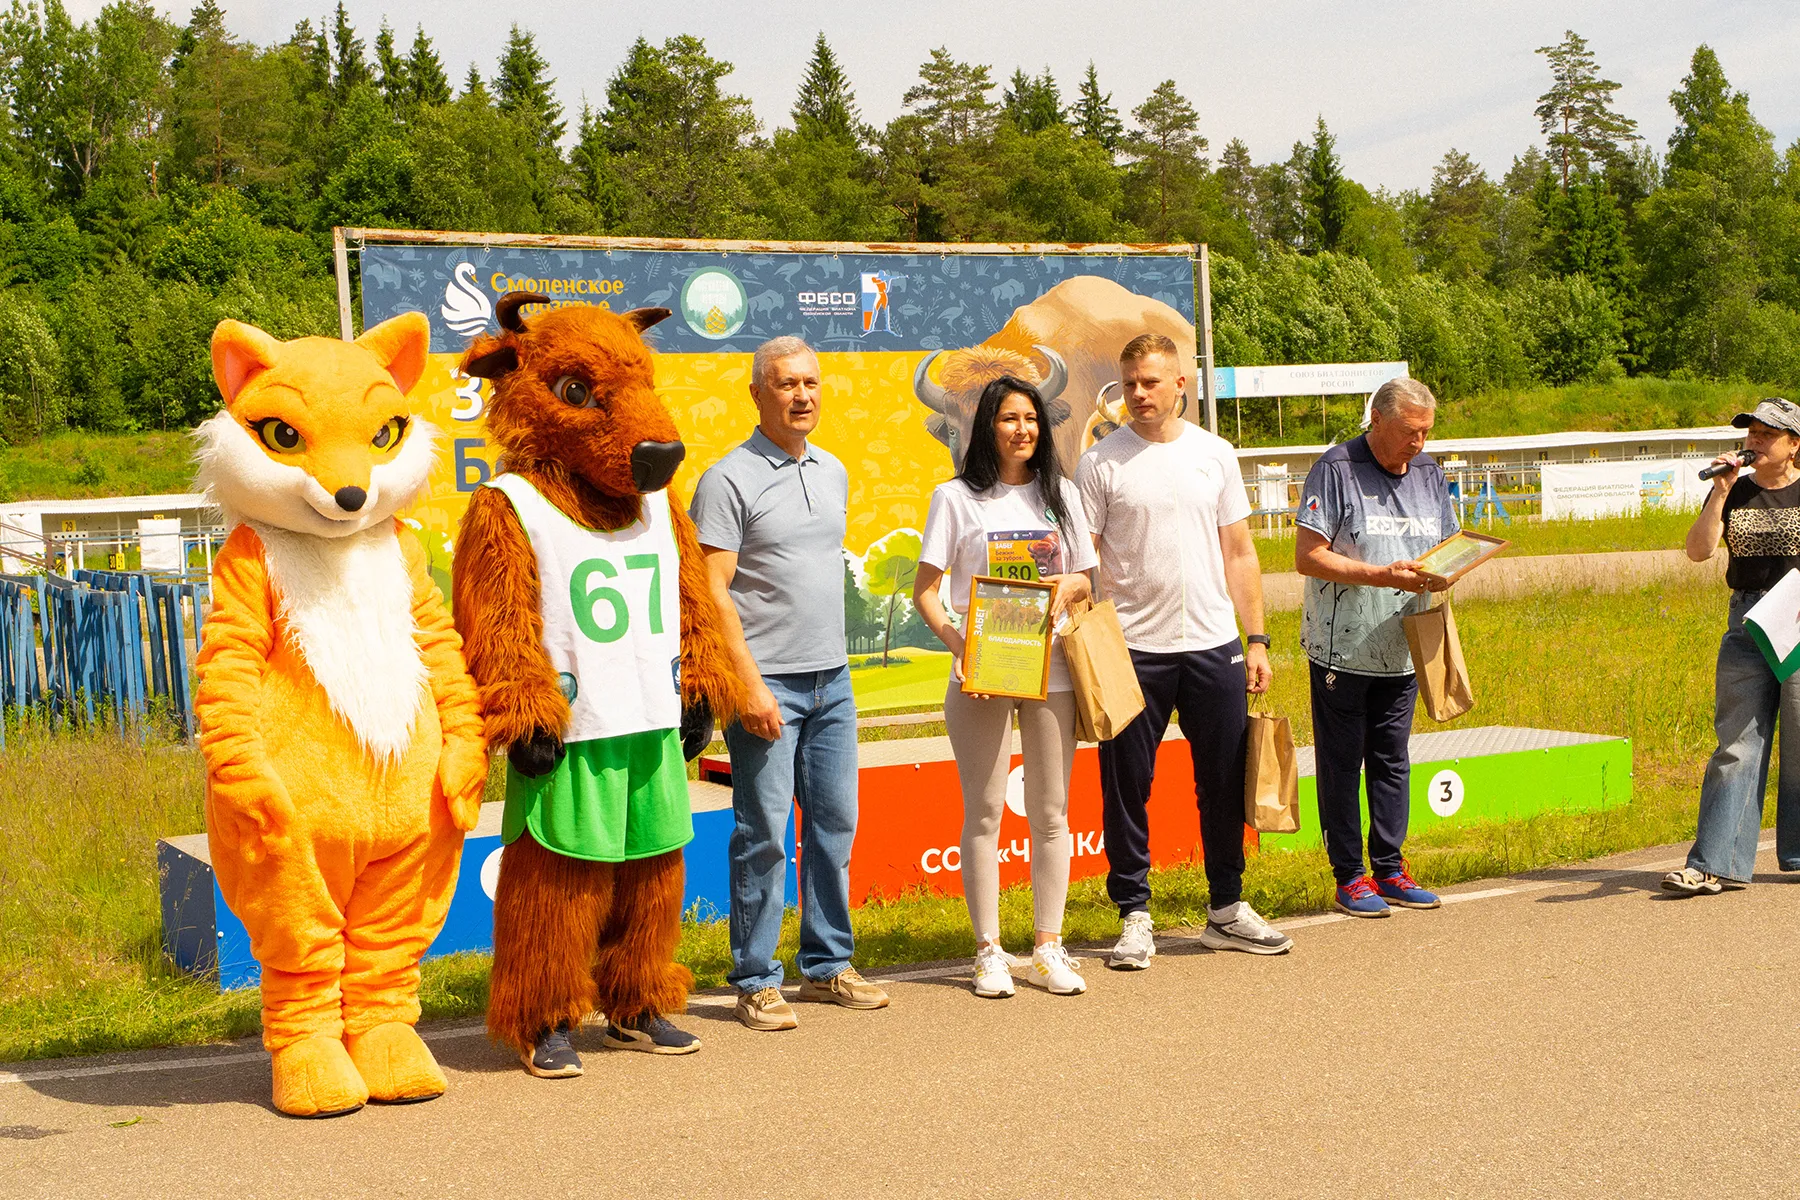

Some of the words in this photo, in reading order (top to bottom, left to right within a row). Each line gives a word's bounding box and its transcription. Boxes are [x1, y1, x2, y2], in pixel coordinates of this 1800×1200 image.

[491, 272, 625, 295] Смоленское
[798, 292, 856, 305] ФБСО
[1289, 371, 1315, 379] СОЮЗ
[1321, 380, 1355, 389] РОССИИ
[1553, 485, 1597, 493] ФЕДЕРАЦИЯ
[1597, 483, 1635, 491] БИАТЛОНА
[1556, 491, 1603, 500] СМОЛЕНСКОЙ
[1604, 490, 1635, 498] ОБЛАСТИ
[1366, 515, 1439, 537] BEIJING
[996, 565, 1032, 581] 180
[569, 553, 664, 643] 67
[973, 606, 985, 637] ЗАБЕГ
[988, 635, 1042, 647] БЛАГОДАРНОСТЬ
[1440, 780, 1453, 803] 3
[921, 845, 962, 874] СО
